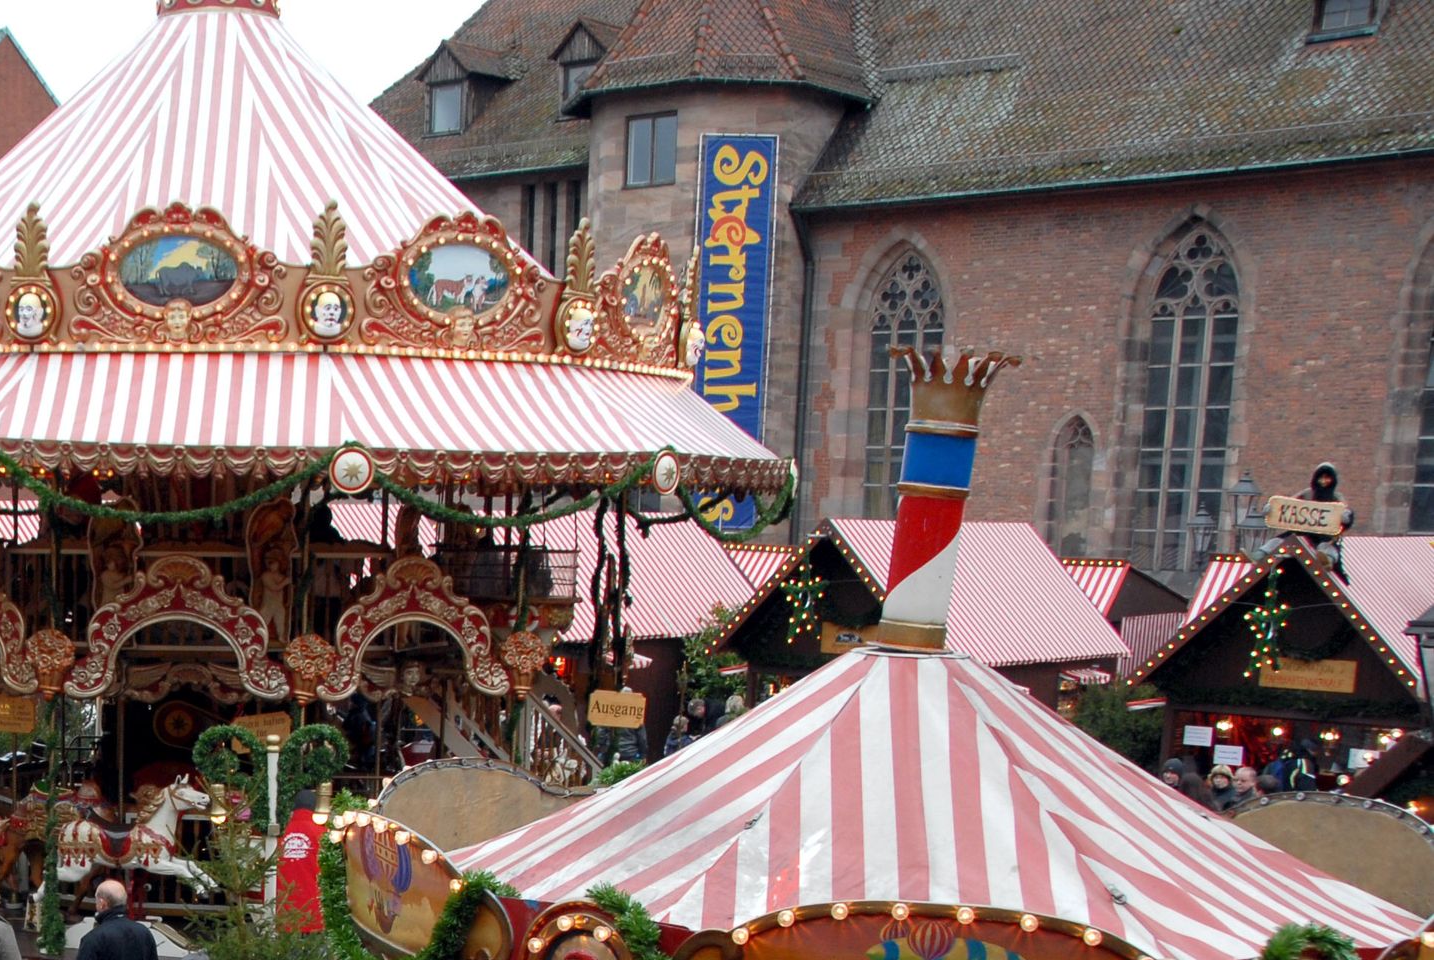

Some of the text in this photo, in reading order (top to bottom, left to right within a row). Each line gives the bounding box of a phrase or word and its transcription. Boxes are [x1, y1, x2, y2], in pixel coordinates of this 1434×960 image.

[698, 144, 769, 525] Sternenhs
[1278, 504, 1331, 527] KASSE
[591, 700, 643, 719] Ausgang
